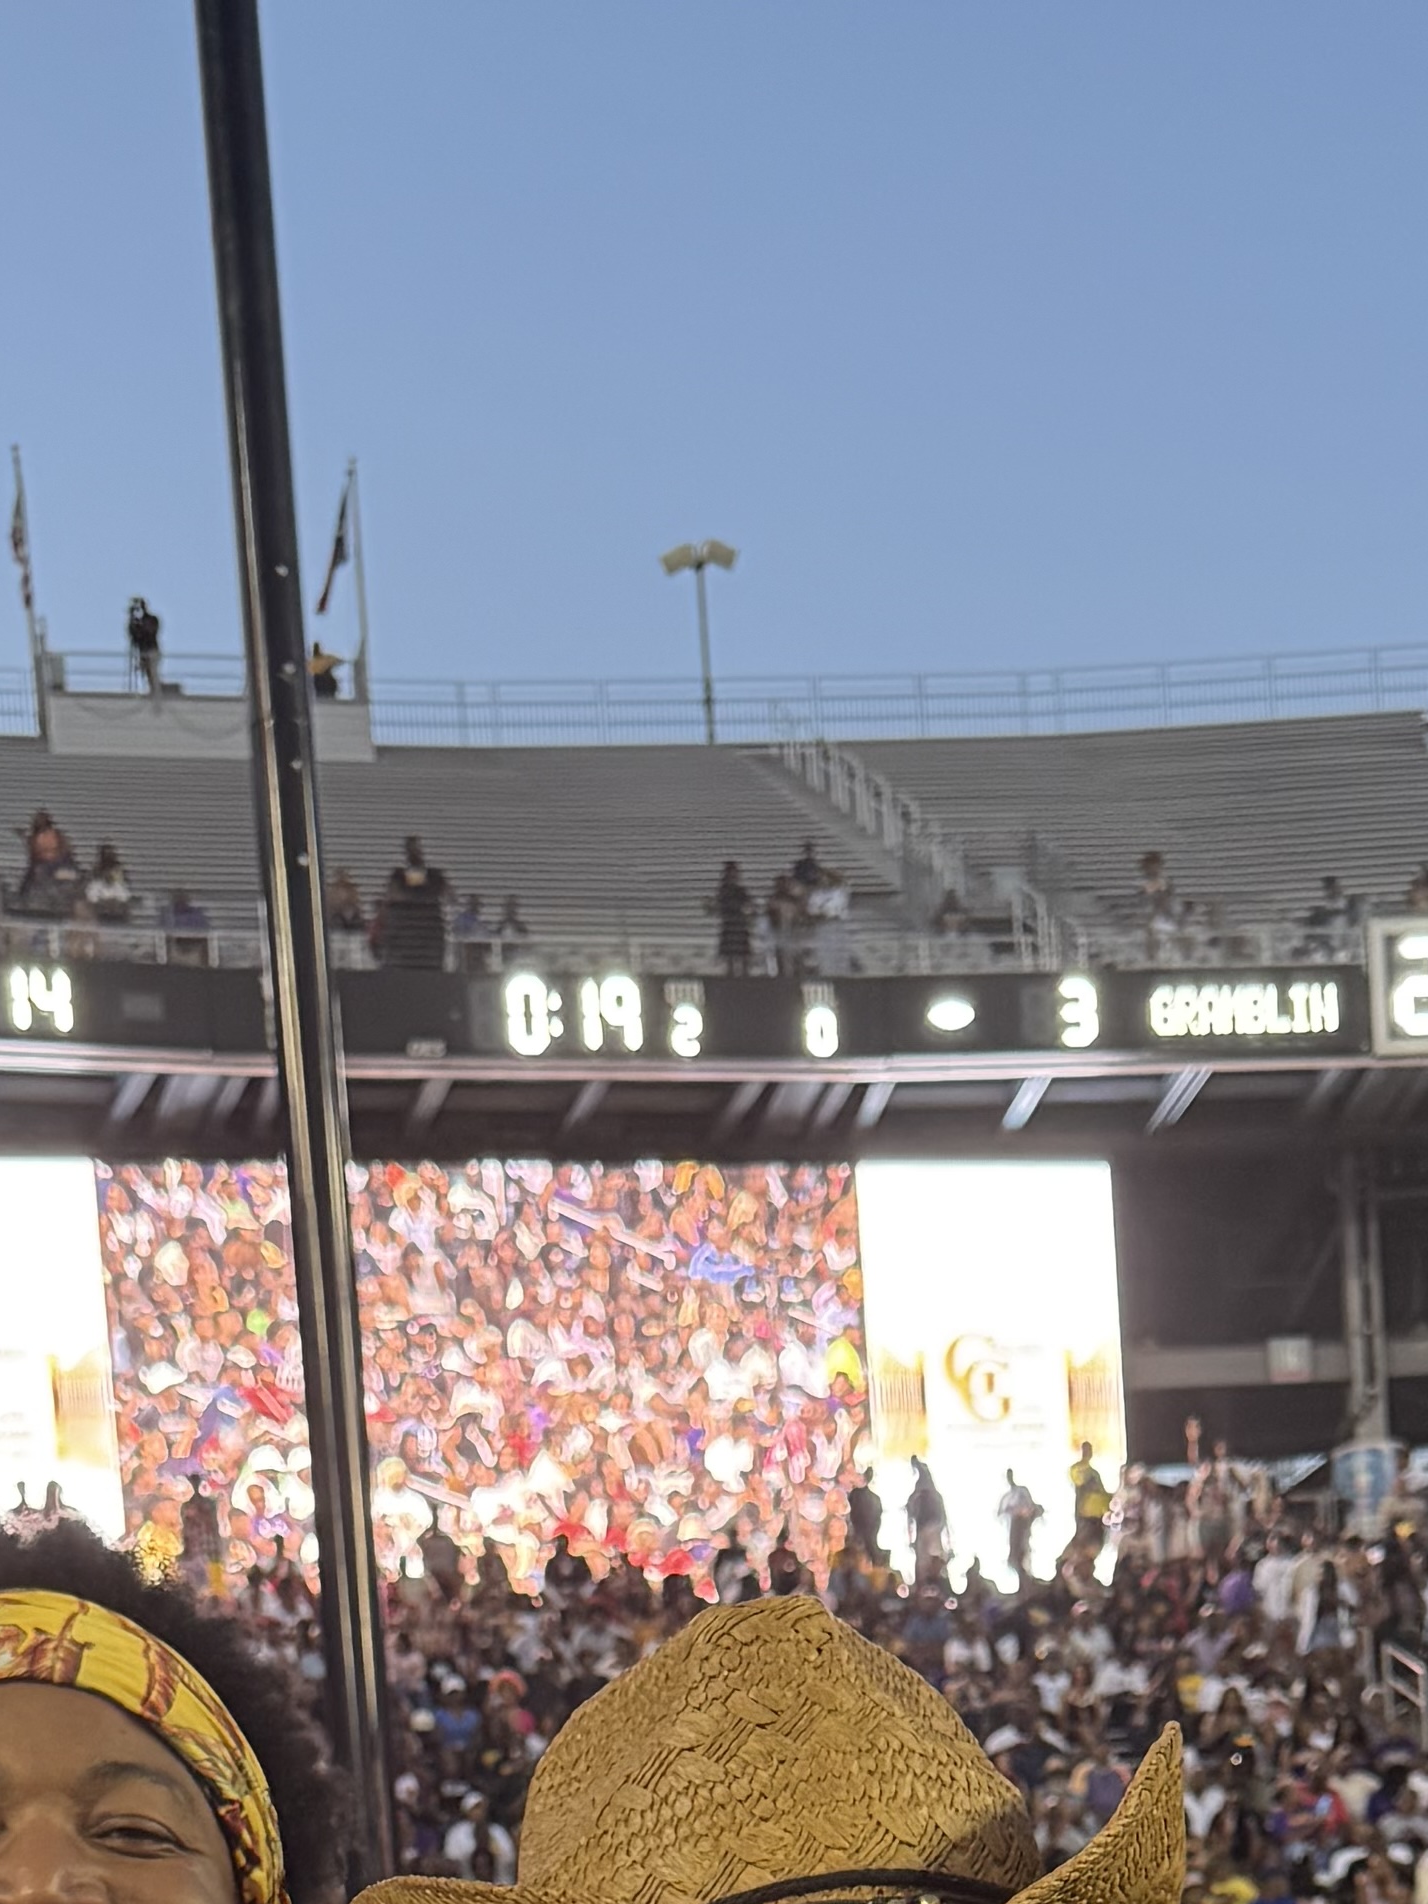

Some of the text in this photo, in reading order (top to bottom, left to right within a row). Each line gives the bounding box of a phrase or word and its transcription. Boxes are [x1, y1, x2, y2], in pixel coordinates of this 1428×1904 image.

[10, 966, 74, 1032] 14
[505, 975, 644, 1056] 0:19
[671, 1004, 704, 1058] 2
[1058, 977, 1100, 1048] 3
